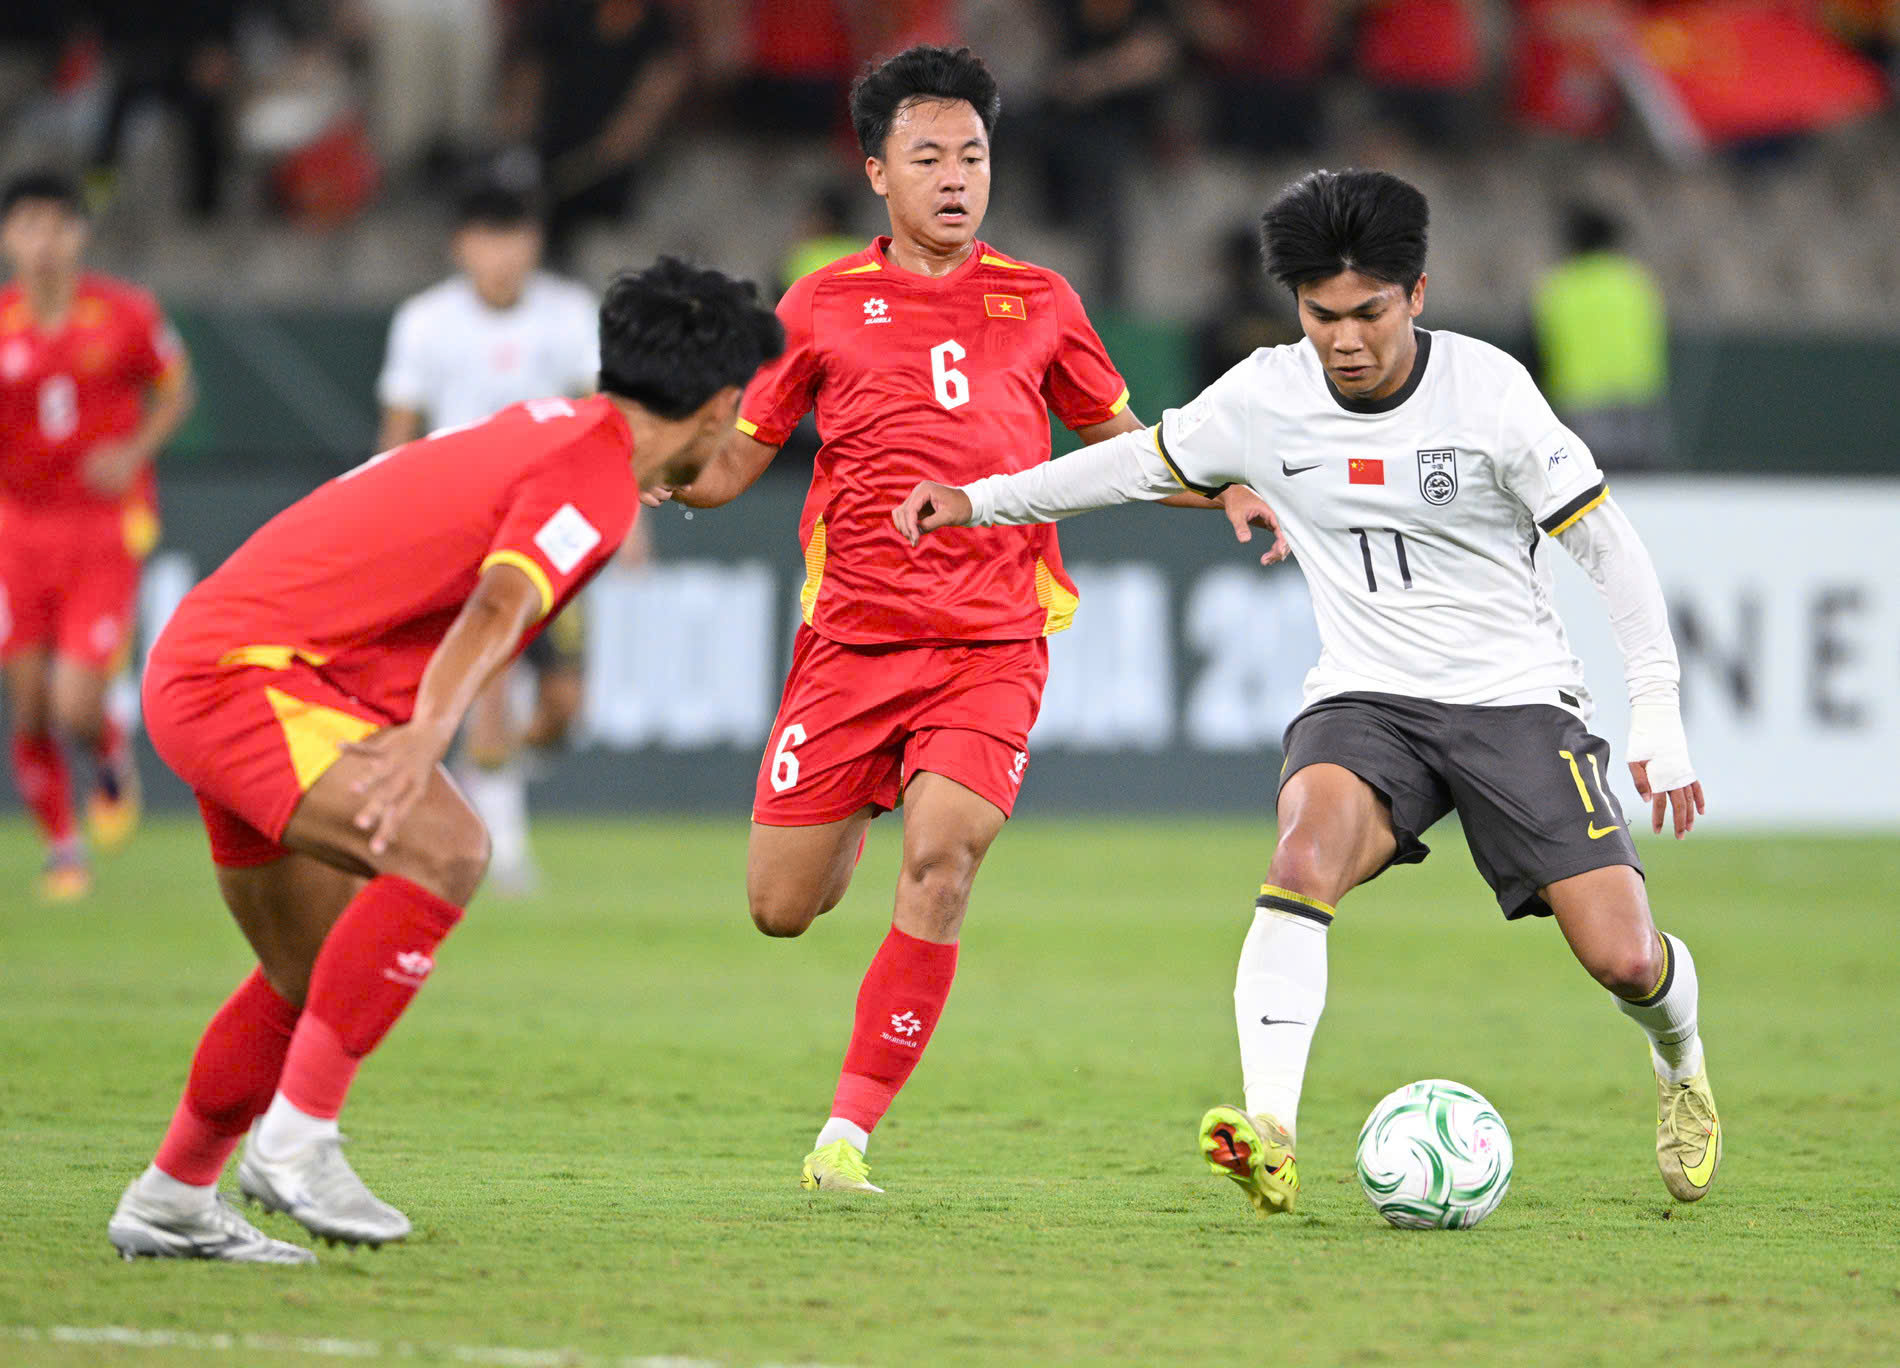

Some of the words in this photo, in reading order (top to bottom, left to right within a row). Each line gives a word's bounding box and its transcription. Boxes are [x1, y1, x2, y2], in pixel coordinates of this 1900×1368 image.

[930, 339, 970, 410] 6
[1421, 452, 1452, 464] CFA
[1548, 447, 1568, 471] AFC
[1348, 527, 1413, 592] 11
[770, 723, 807, 793] 6
[1559, 750, 1616, 818] 11
